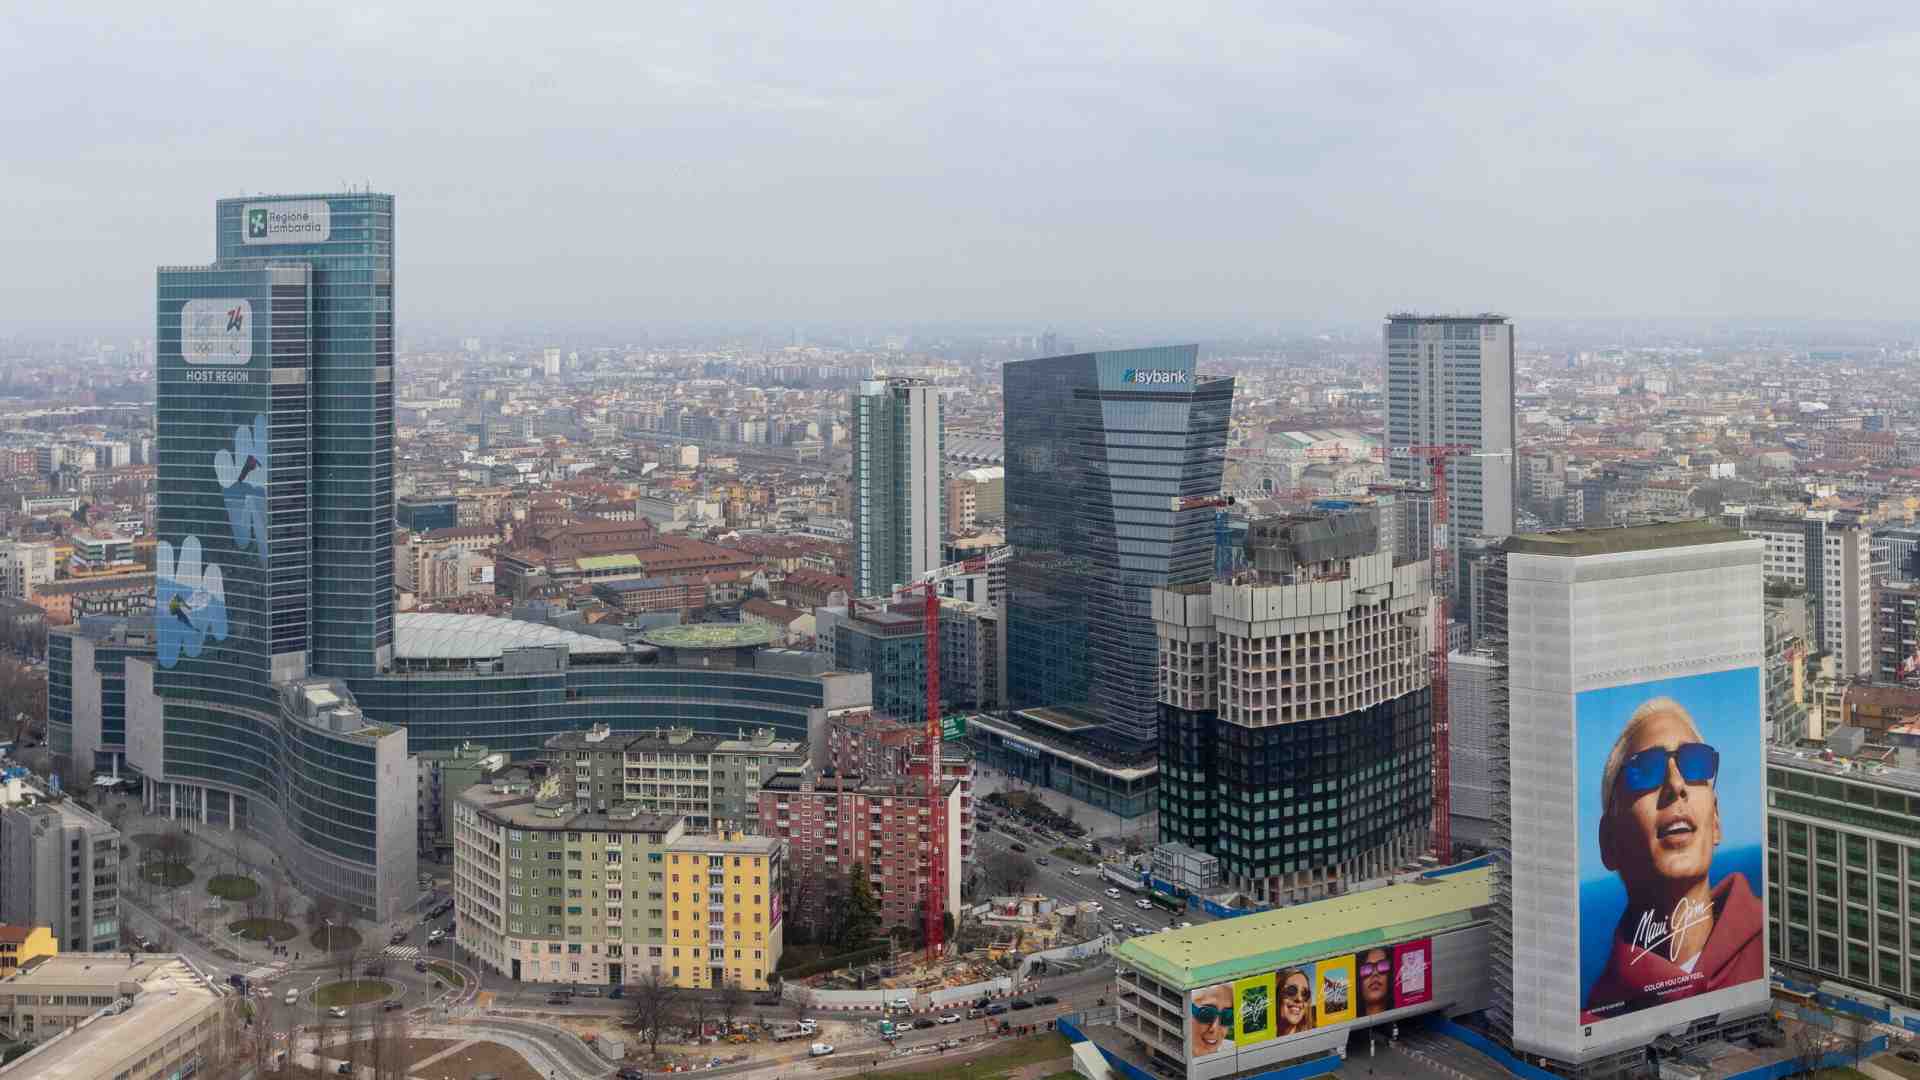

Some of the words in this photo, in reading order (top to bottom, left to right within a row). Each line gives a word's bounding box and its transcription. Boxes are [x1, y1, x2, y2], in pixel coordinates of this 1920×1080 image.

[270, 212, 309, 224] Regione
[270, 222, 321, 233] Lombardia
[186, 370, 213, 382] HOST
[215, 371, 249, 383] REGION
[1631, 908, 1669, 953] Maui
[1670, 897, 1714, 962] Jim
[1643, 981, 1665, 992] COLOR
